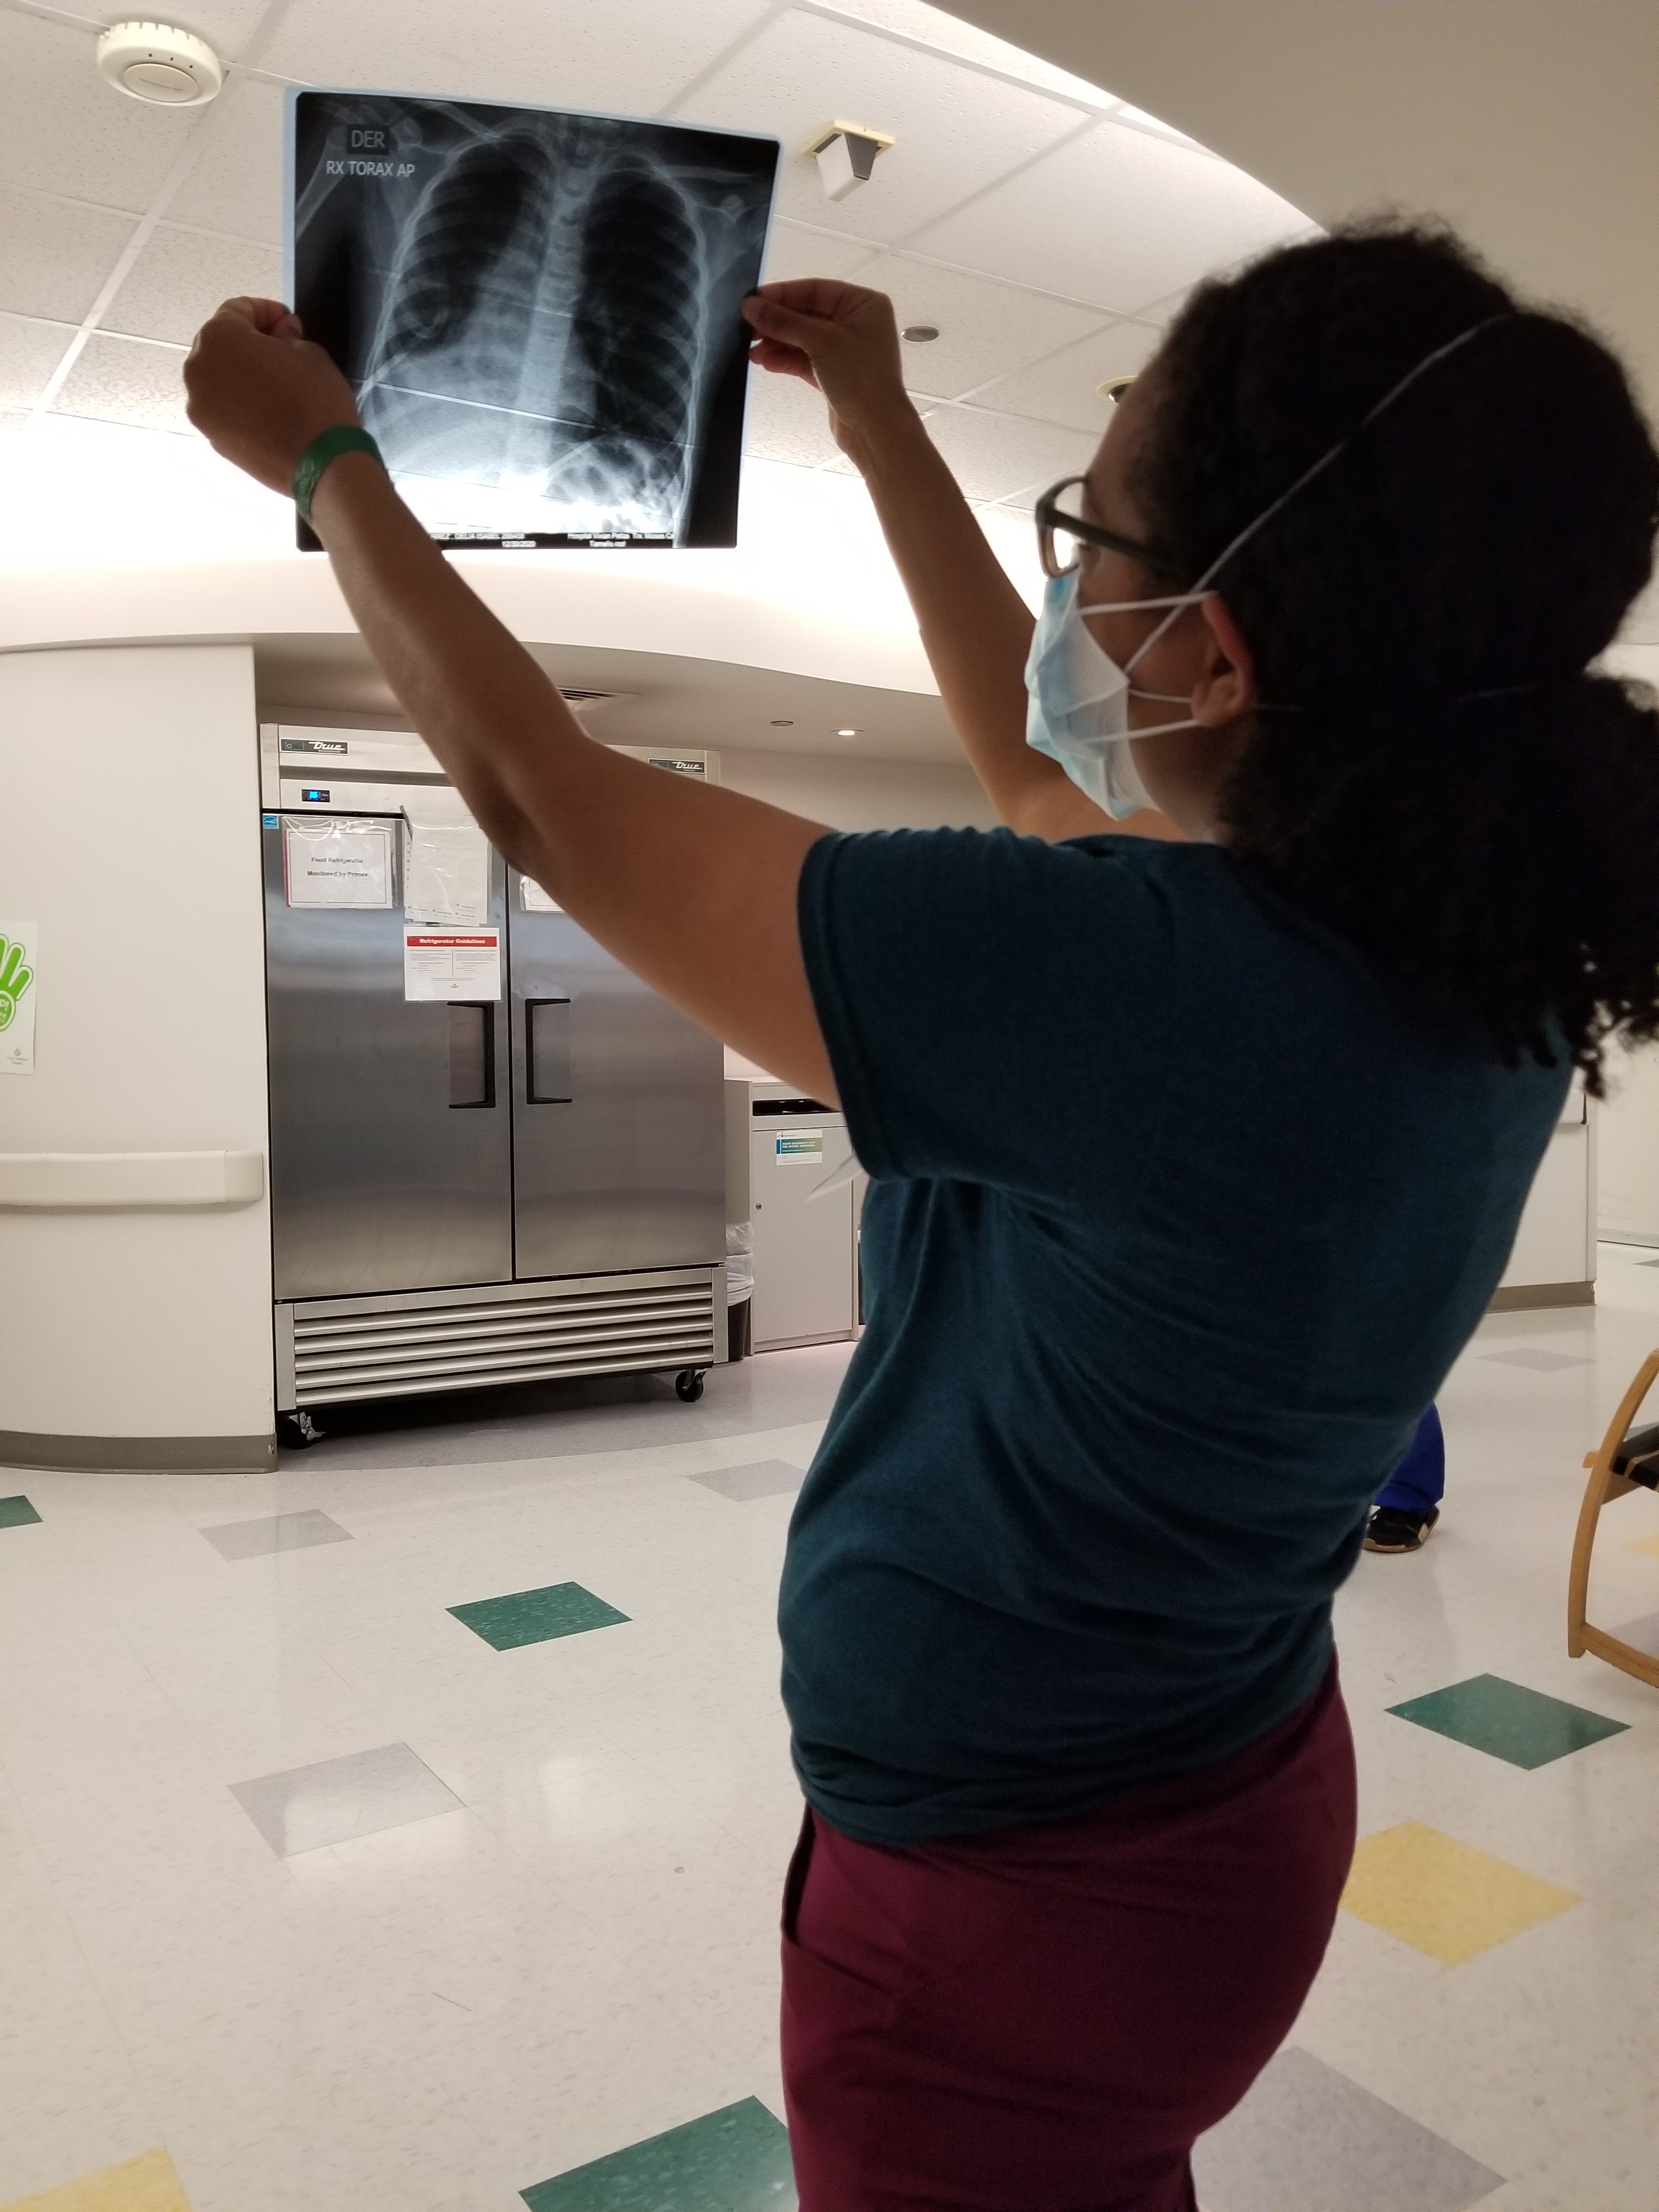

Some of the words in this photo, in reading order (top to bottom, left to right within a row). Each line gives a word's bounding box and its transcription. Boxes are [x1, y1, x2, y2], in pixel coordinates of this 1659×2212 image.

[351, 129, 386, 148] DER
[326, 160, 345, 175] RX
[347, 161, 394, 177] TORAX
[396, 163, 416, 178] AP
